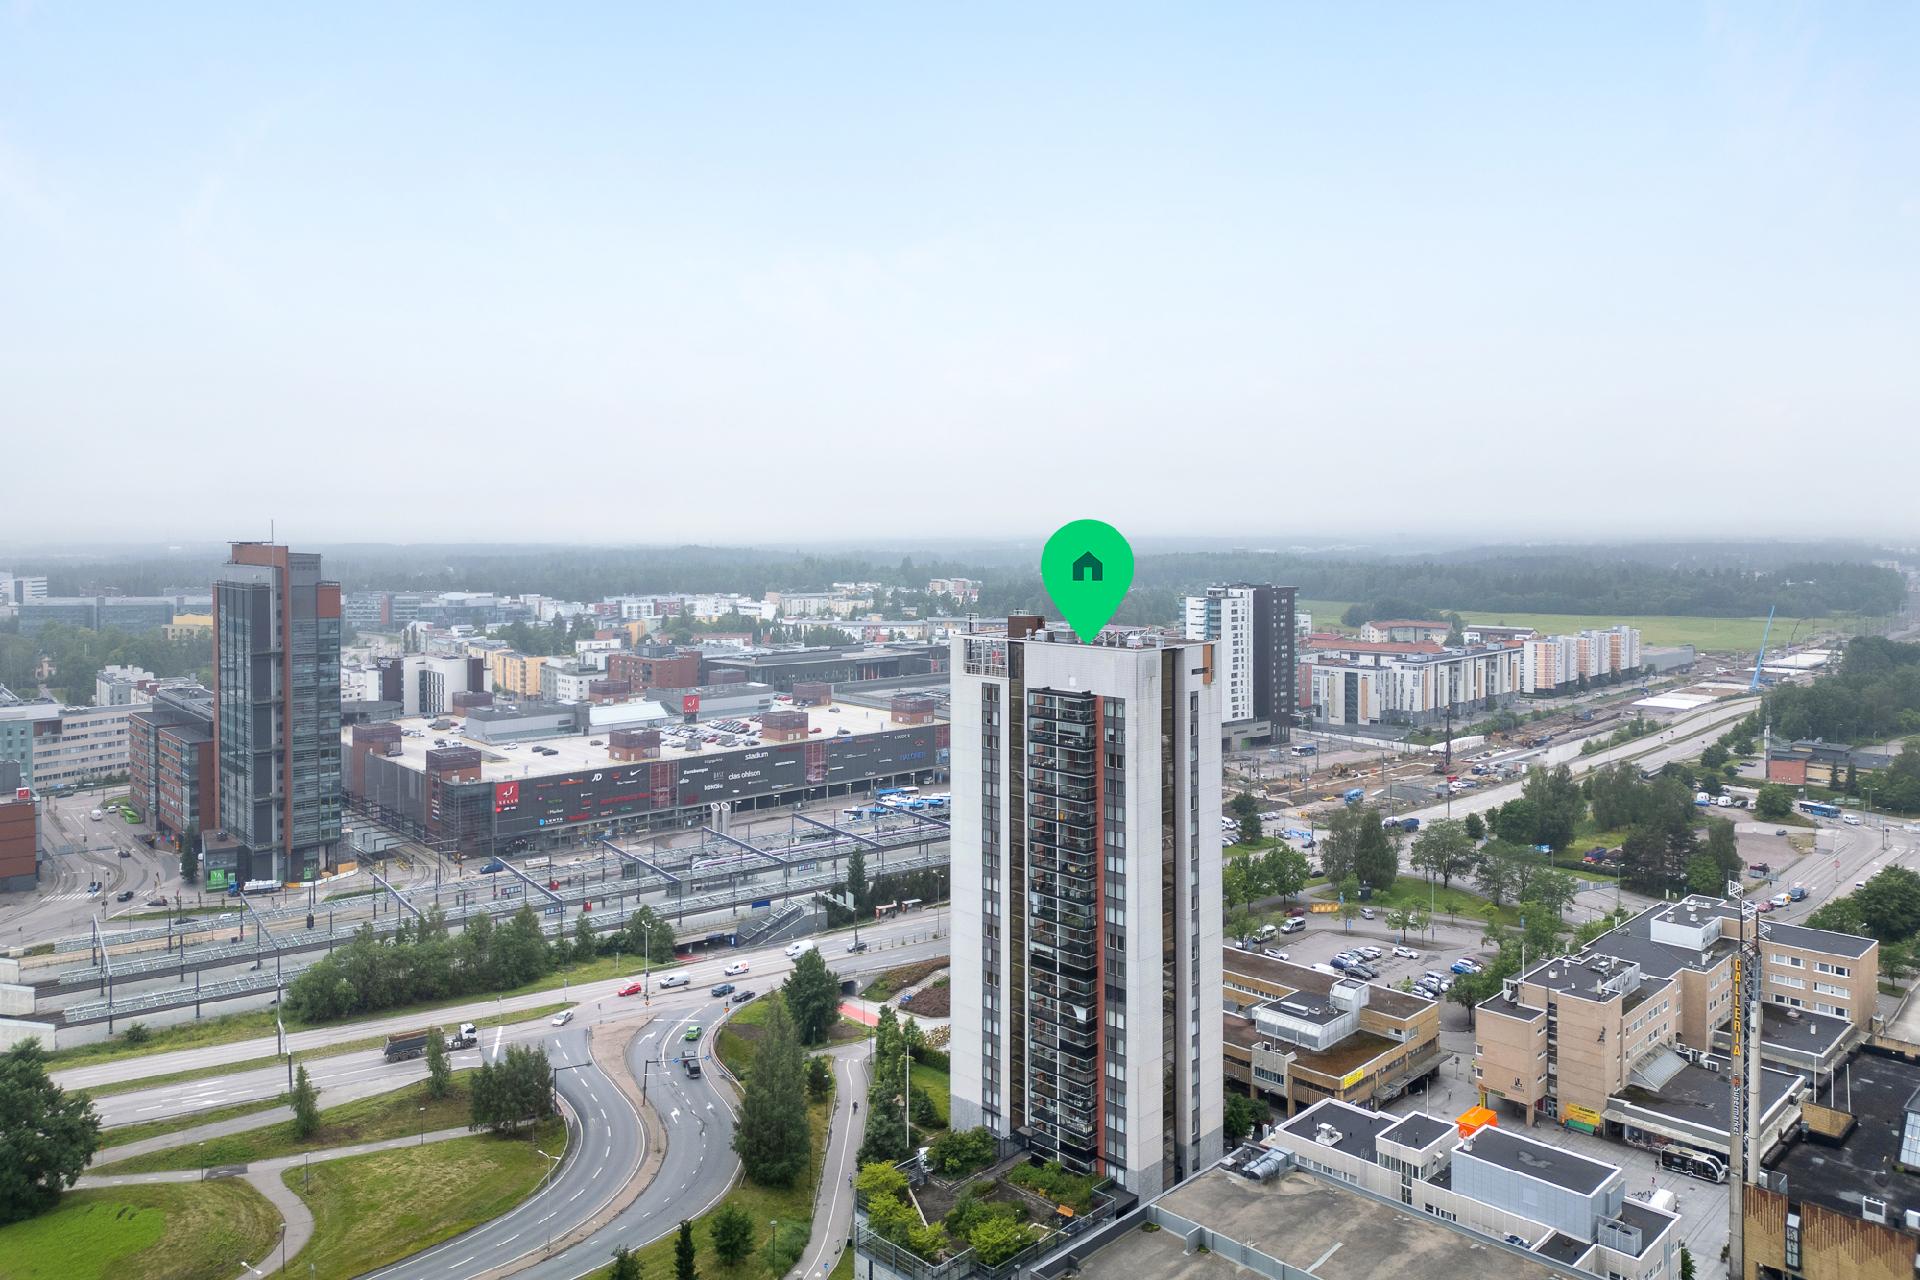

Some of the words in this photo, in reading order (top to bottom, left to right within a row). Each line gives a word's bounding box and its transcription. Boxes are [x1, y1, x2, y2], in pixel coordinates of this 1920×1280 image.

[745, 752, 769, 760] stadium
[592, 773, 602, 782] JD
[728, 772, 741, 780] clas
[741, 770, 761, 778] ohlson
[1733, 959, 1741, 1057] GALLERIA
[1733, 1086, 1741, 1137] Supermarket
